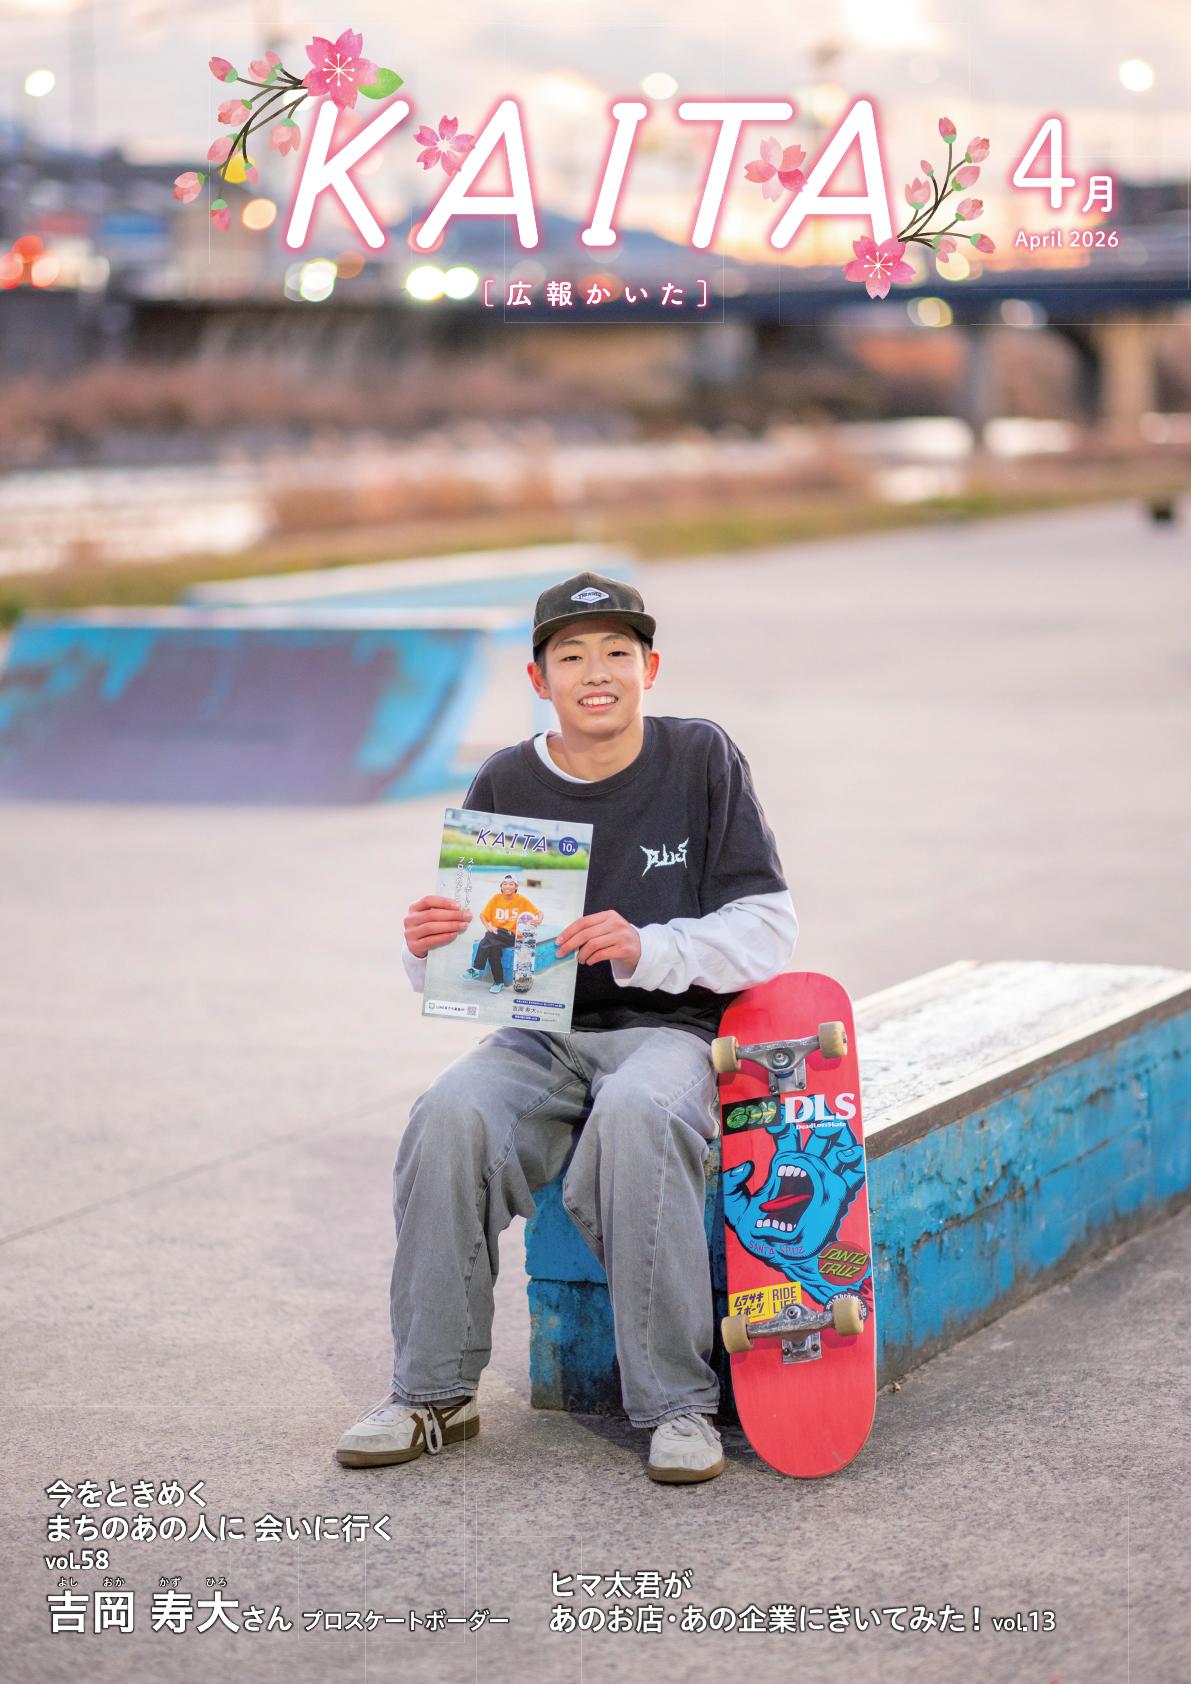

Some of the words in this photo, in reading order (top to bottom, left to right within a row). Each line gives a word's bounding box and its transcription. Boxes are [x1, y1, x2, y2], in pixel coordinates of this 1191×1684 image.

[476, 828, 548, 853] KAITA
[784, 1092, 857, 1123] DLS
[817, 1247, 868, 1266] SANTA
[819, 1262, 862, 1278] CRUZ
[734, 1291, 765, 1308] ムラサキ
[772, 1285, 797, 1301] RIDE
[736, 1302, 765, 1316] スポーツ
